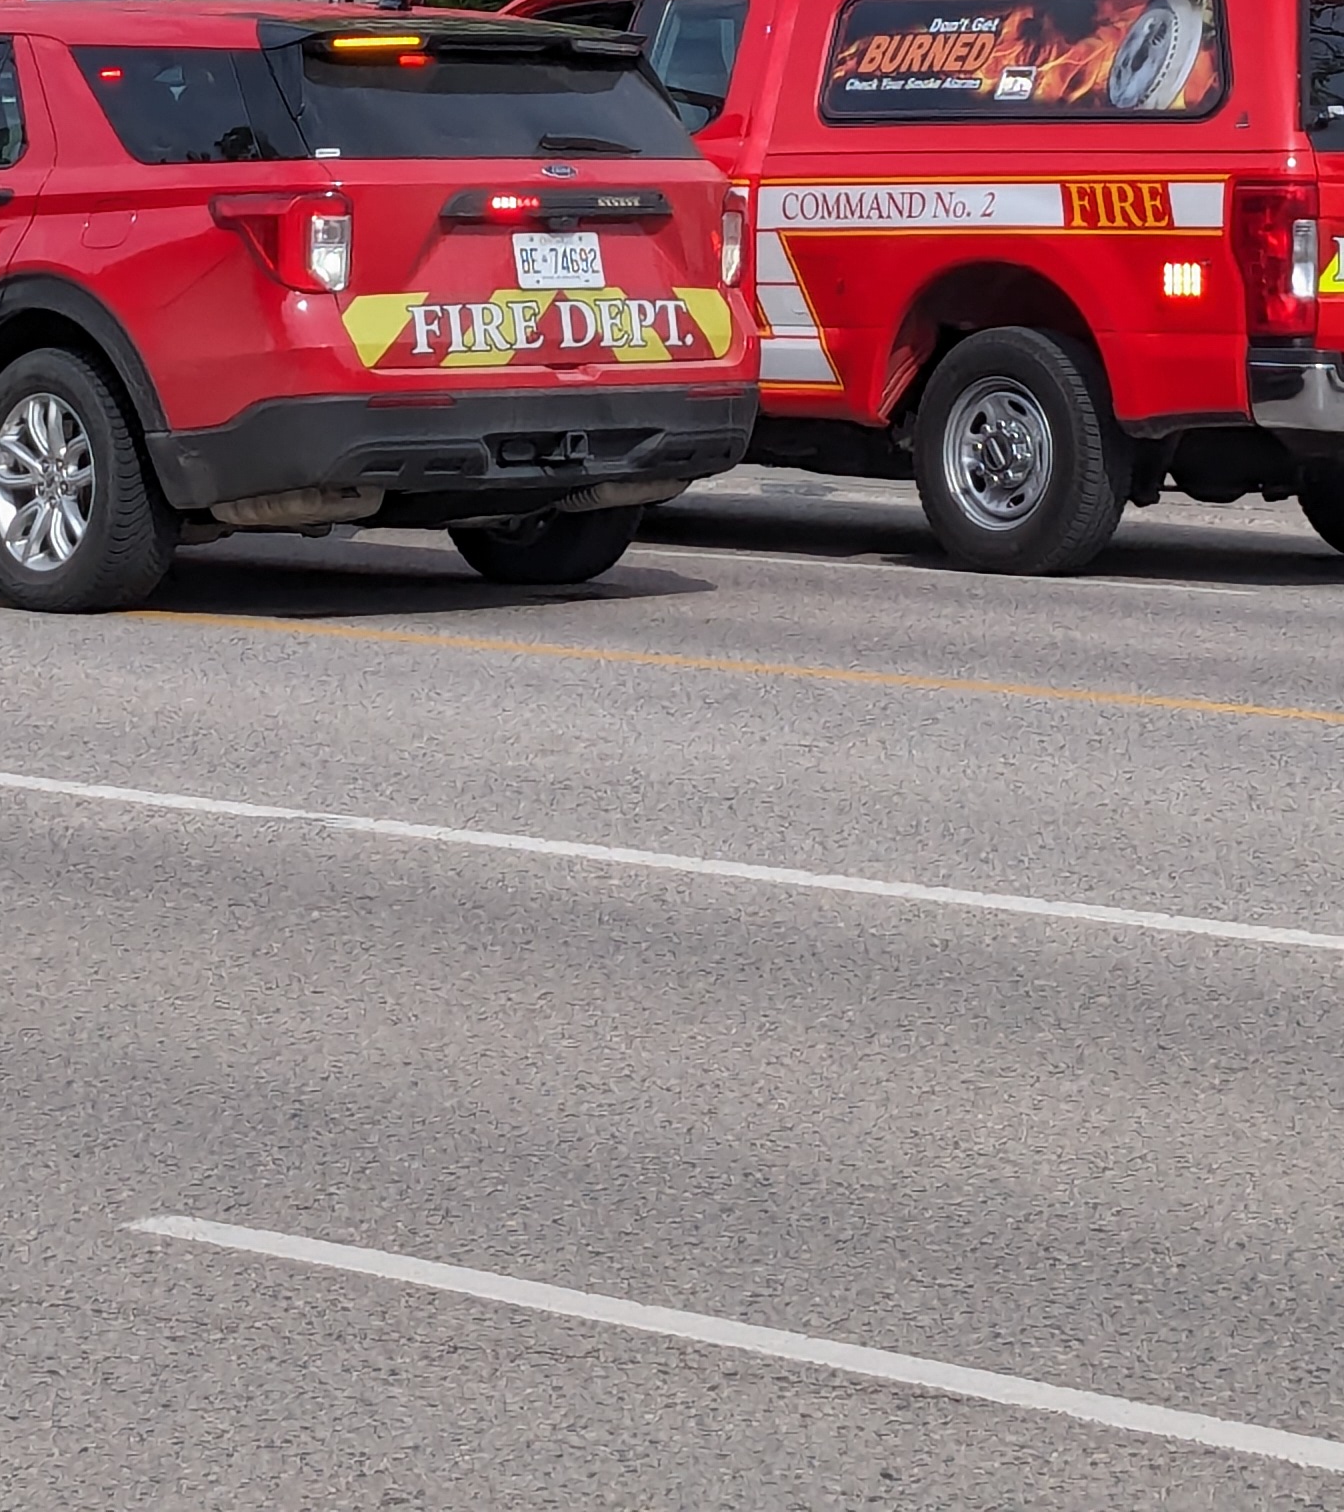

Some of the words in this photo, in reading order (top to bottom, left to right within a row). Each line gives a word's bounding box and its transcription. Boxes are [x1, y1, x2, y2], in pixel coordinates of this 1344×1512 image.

[929, 18, 967, 32] Don't
[971, 18, 999, 32] Get
[858, 33, 996, 72] BURNED
[782, 192, 926, 220] COMMAND
[931, 192, 971, 219] No.
[980, 191, 996, 218] 2
[1069, 182, 1170, 227] FIRE
[549, 248, 601, 274] 74692
[407, 299, 544, 354] FIRE
[555, 299, 694, 350] DEPT.
